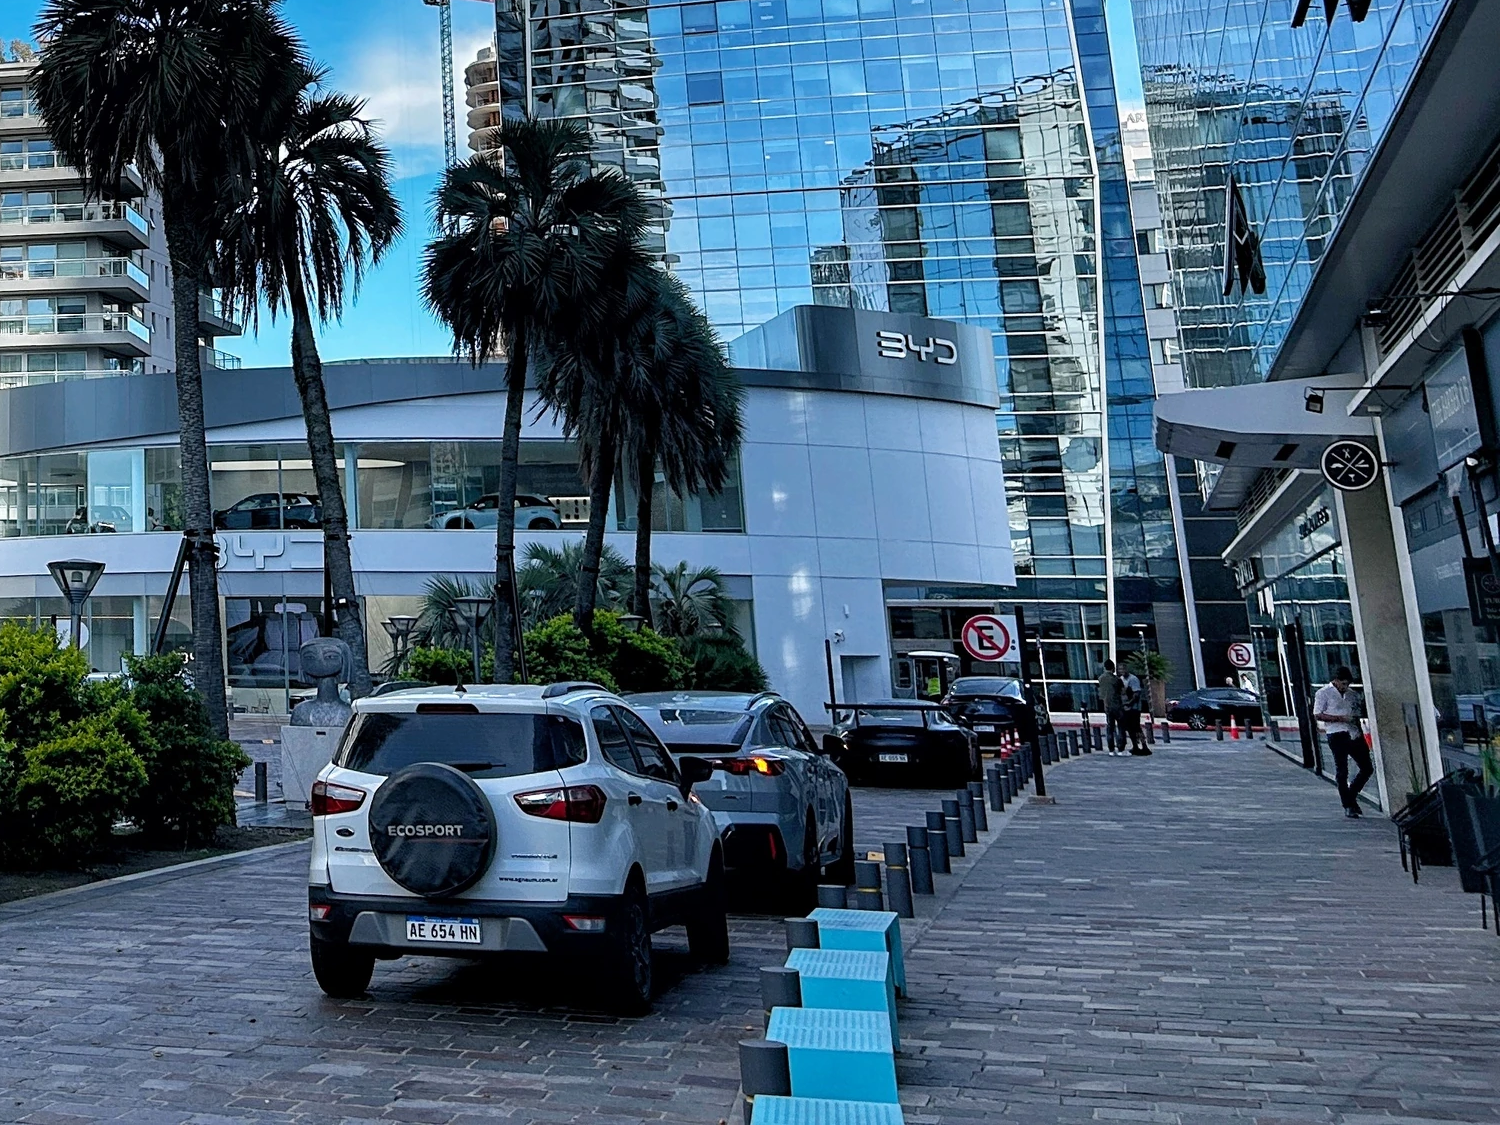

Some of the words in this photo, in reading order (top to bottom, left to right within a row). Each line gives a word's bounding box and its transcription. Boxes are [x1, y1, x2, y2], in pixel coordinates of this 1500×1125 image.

[879, 330, 958, 365] BYD
[387, 824, 464, 837] ECOSPORT
[410, 923, 426, 938] AE
[431, 924, 455, 939] 654
[460, 925, 477, 940] HN
